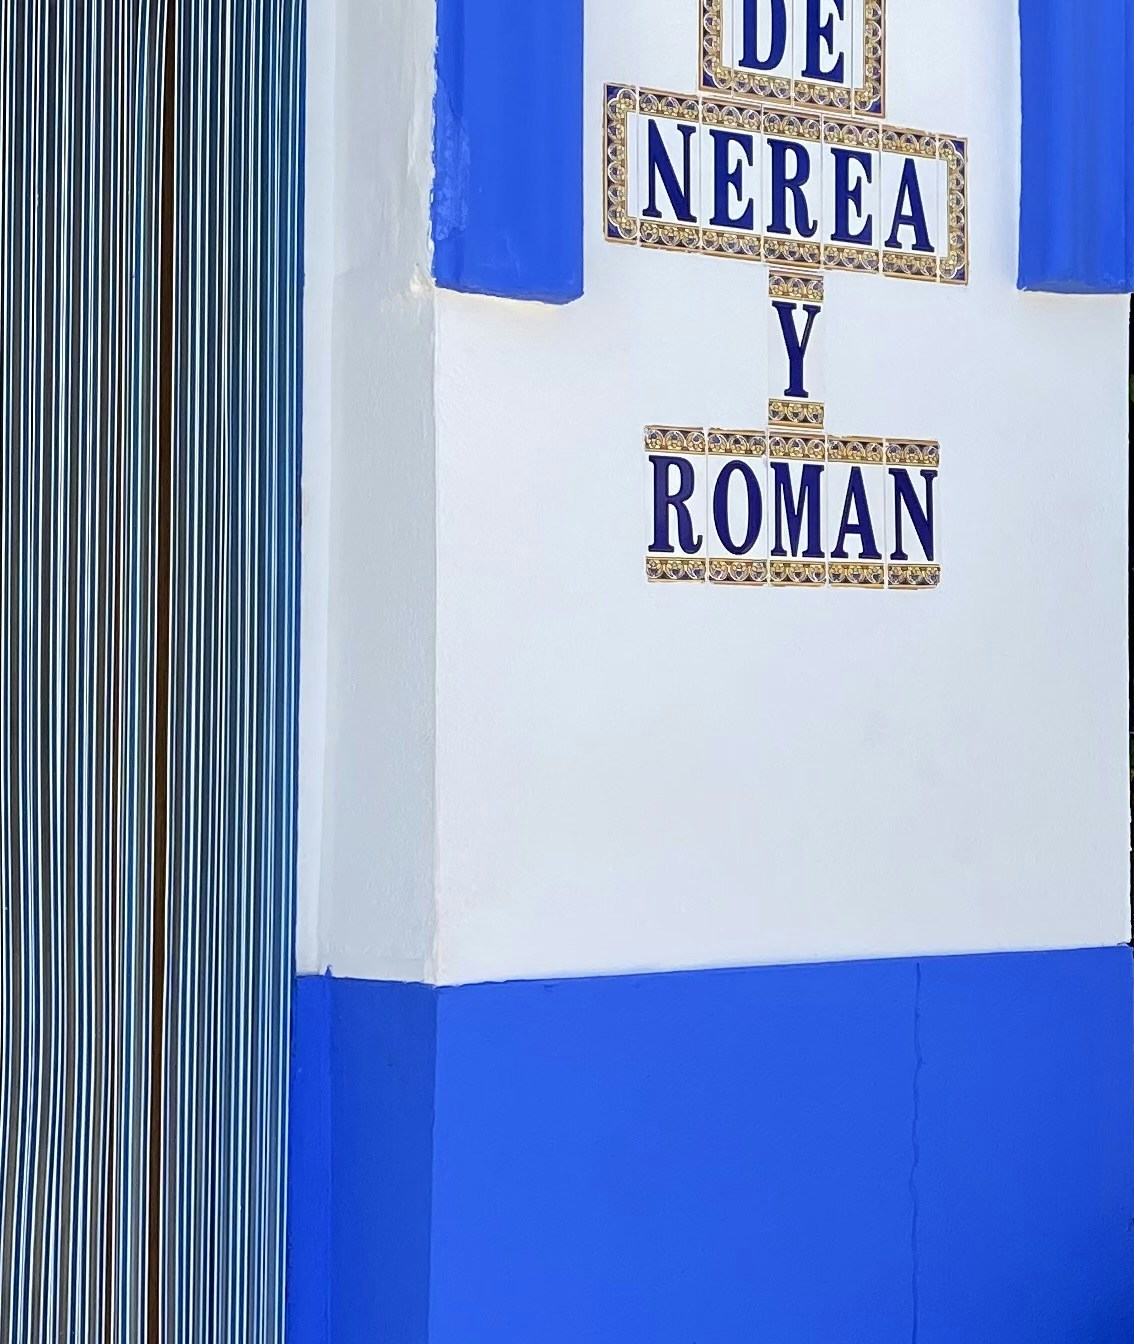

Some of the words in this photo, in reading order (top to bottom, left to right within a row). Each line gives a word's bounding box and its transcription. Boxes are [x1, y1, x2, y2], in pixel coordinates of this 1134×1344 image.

[641, 118, 935, 254] NEREA
[771, 300, 822, 399] Y
[647, 454, 938, 562] ROMAN
